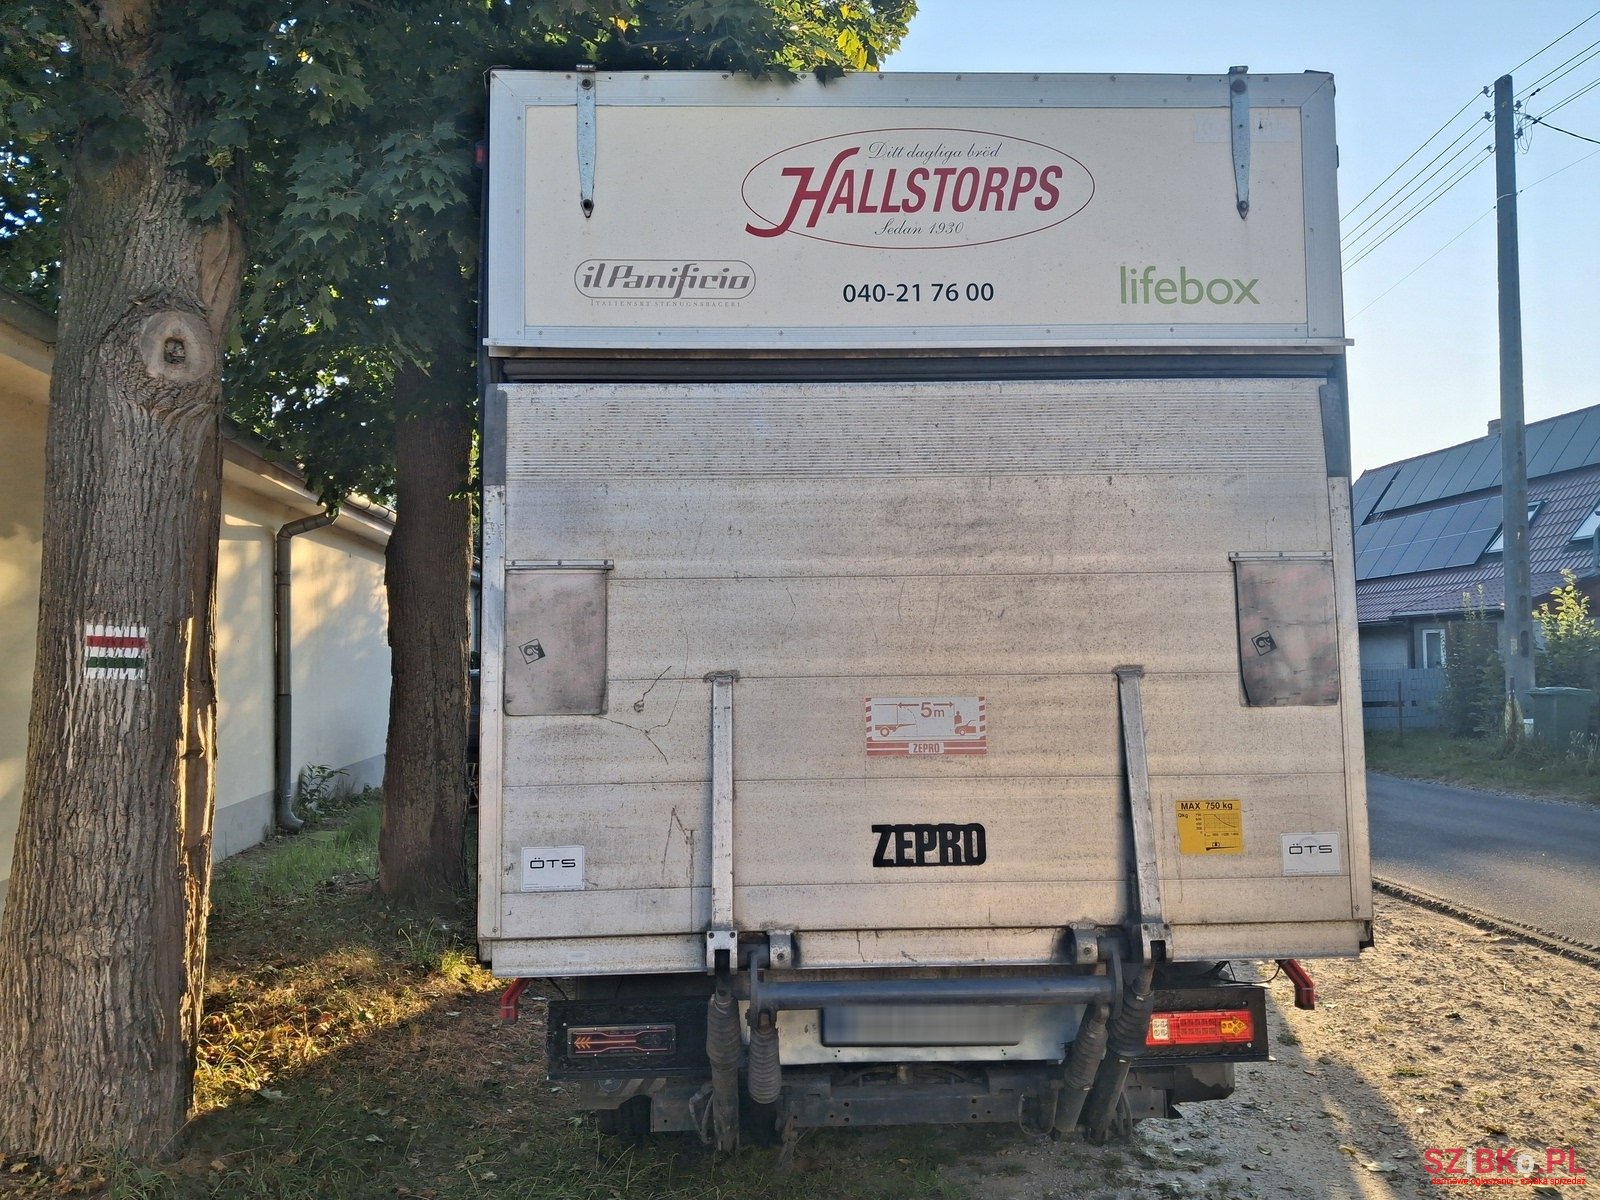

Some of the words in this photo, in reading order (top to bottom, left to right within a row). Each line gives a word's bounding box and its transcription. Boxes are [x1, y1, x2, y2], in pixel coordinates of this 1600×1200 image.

[868, 140, 904, 159] Ditt
[906, 143, 963, 165] dagliga
[966, 142, 1003, 159] bröd
[744, 146, 1064, 238] HALLSTORPS
[874, 217, 922, 236] Sedan
[928, 221, 965, 235] 1930
[583, 262, 606, 289] il
[607, 262, 750, 299] Panificio
[1120, 265, 1261, 305] lifebox
[843, 282, 921, 302] 040-21
[931, 283, 960, 302] 76
[965, 282, 995, 302] 00
[912, 743, 940, 754] ZEPRO
[1181, 802, 1201, 810] MAX
[1206, 801, 1221, 810] 750
[1222, 801, 1233, 811] kg
[871, 822, 987, 867] ZEPRO
[1288, 843, 1333, 855] ÖTS
[529, 857, 576, 869] ÖTS
